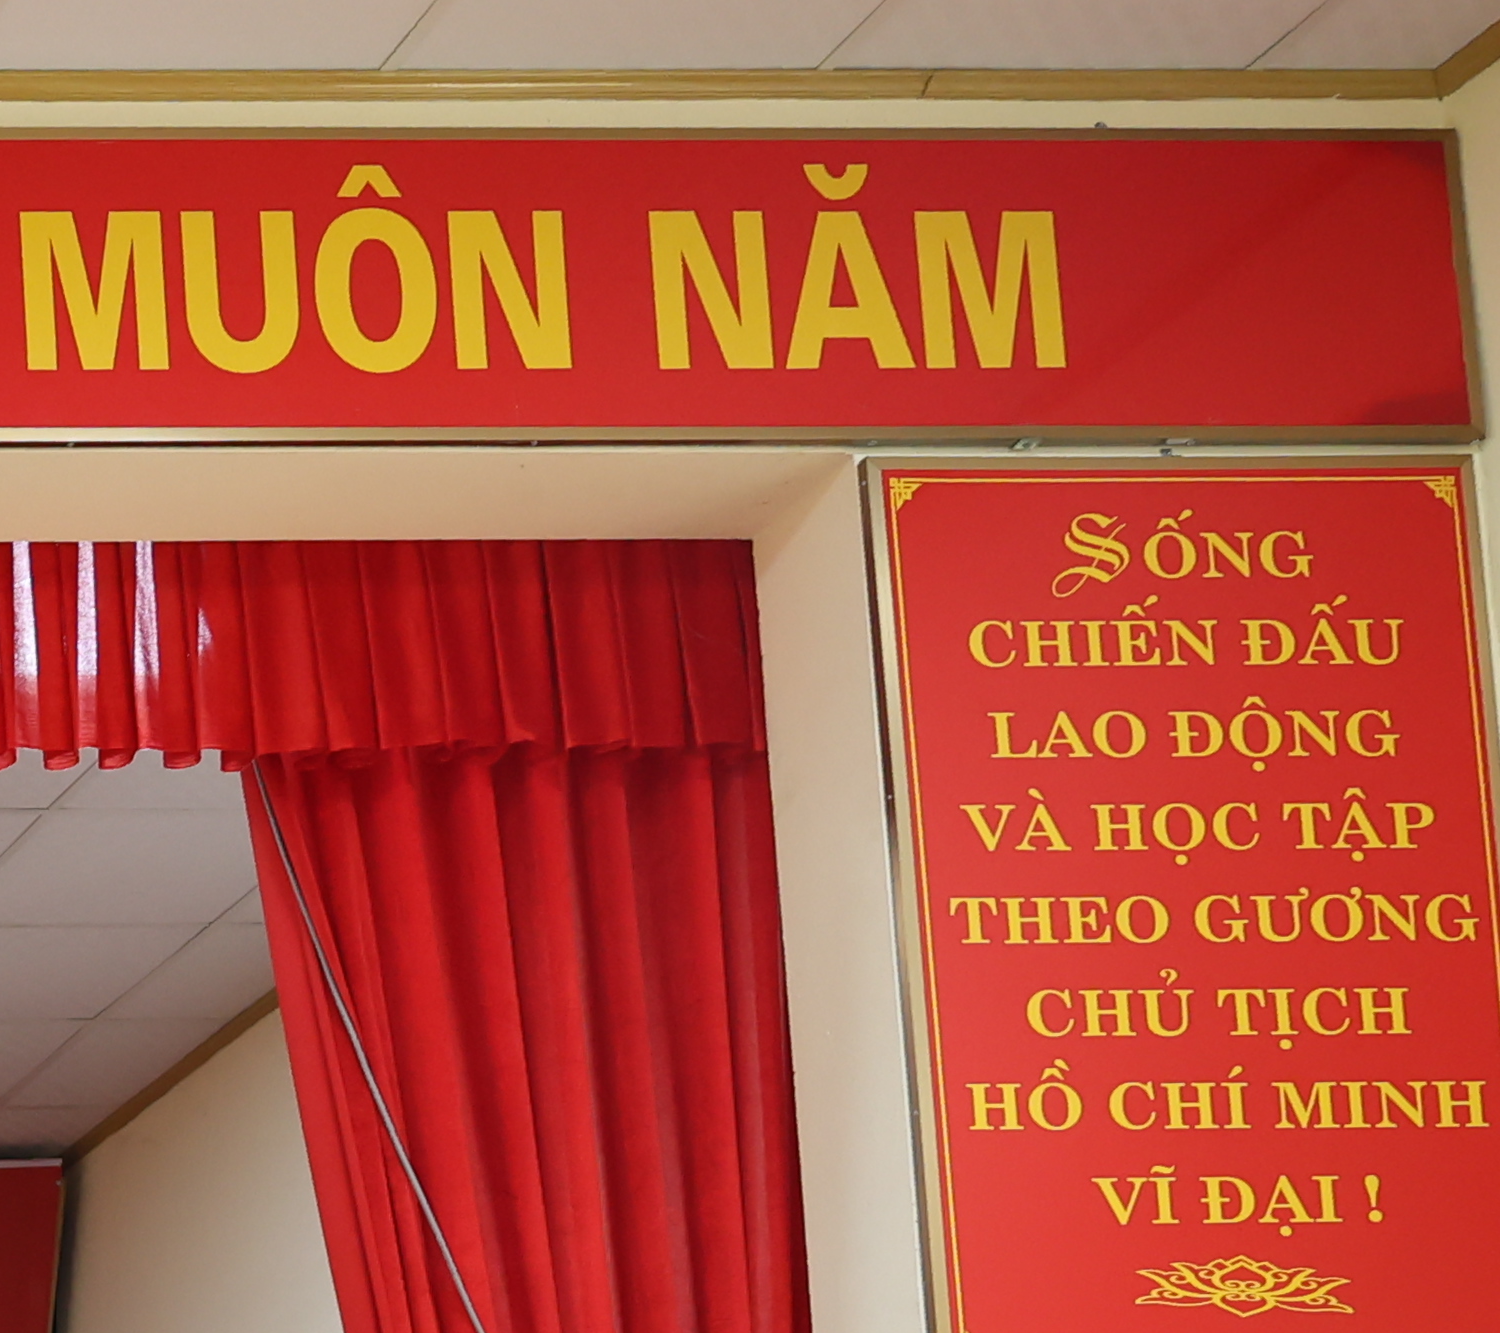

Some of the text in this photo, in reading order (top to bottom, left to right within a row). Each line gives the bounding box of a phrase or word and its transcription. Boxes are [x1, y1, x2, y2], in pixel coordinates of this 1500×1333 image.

[20, 165, 574, 375] MUÔN
[649, 164, 1068, 371] NĂM
[1052, 509, 1315, 599] SỐNG
[969, 595, 1404, 669] CHIẾN ĐẤU
[991, 697, 1401, 773] LAO ĐỘNG
[962, 788, 1436, 866] VÀ HỌC TẬP
[950, 888, 1480, 945] THEO GƯƠNG
[1027, 969, 1412, 1051] CHỦ TỊCH
[968, 1060, 1490, 1132] HỒ CHÍ MINH
[1094, 1166, 1385, 1238] VĨ ĐẠI !
